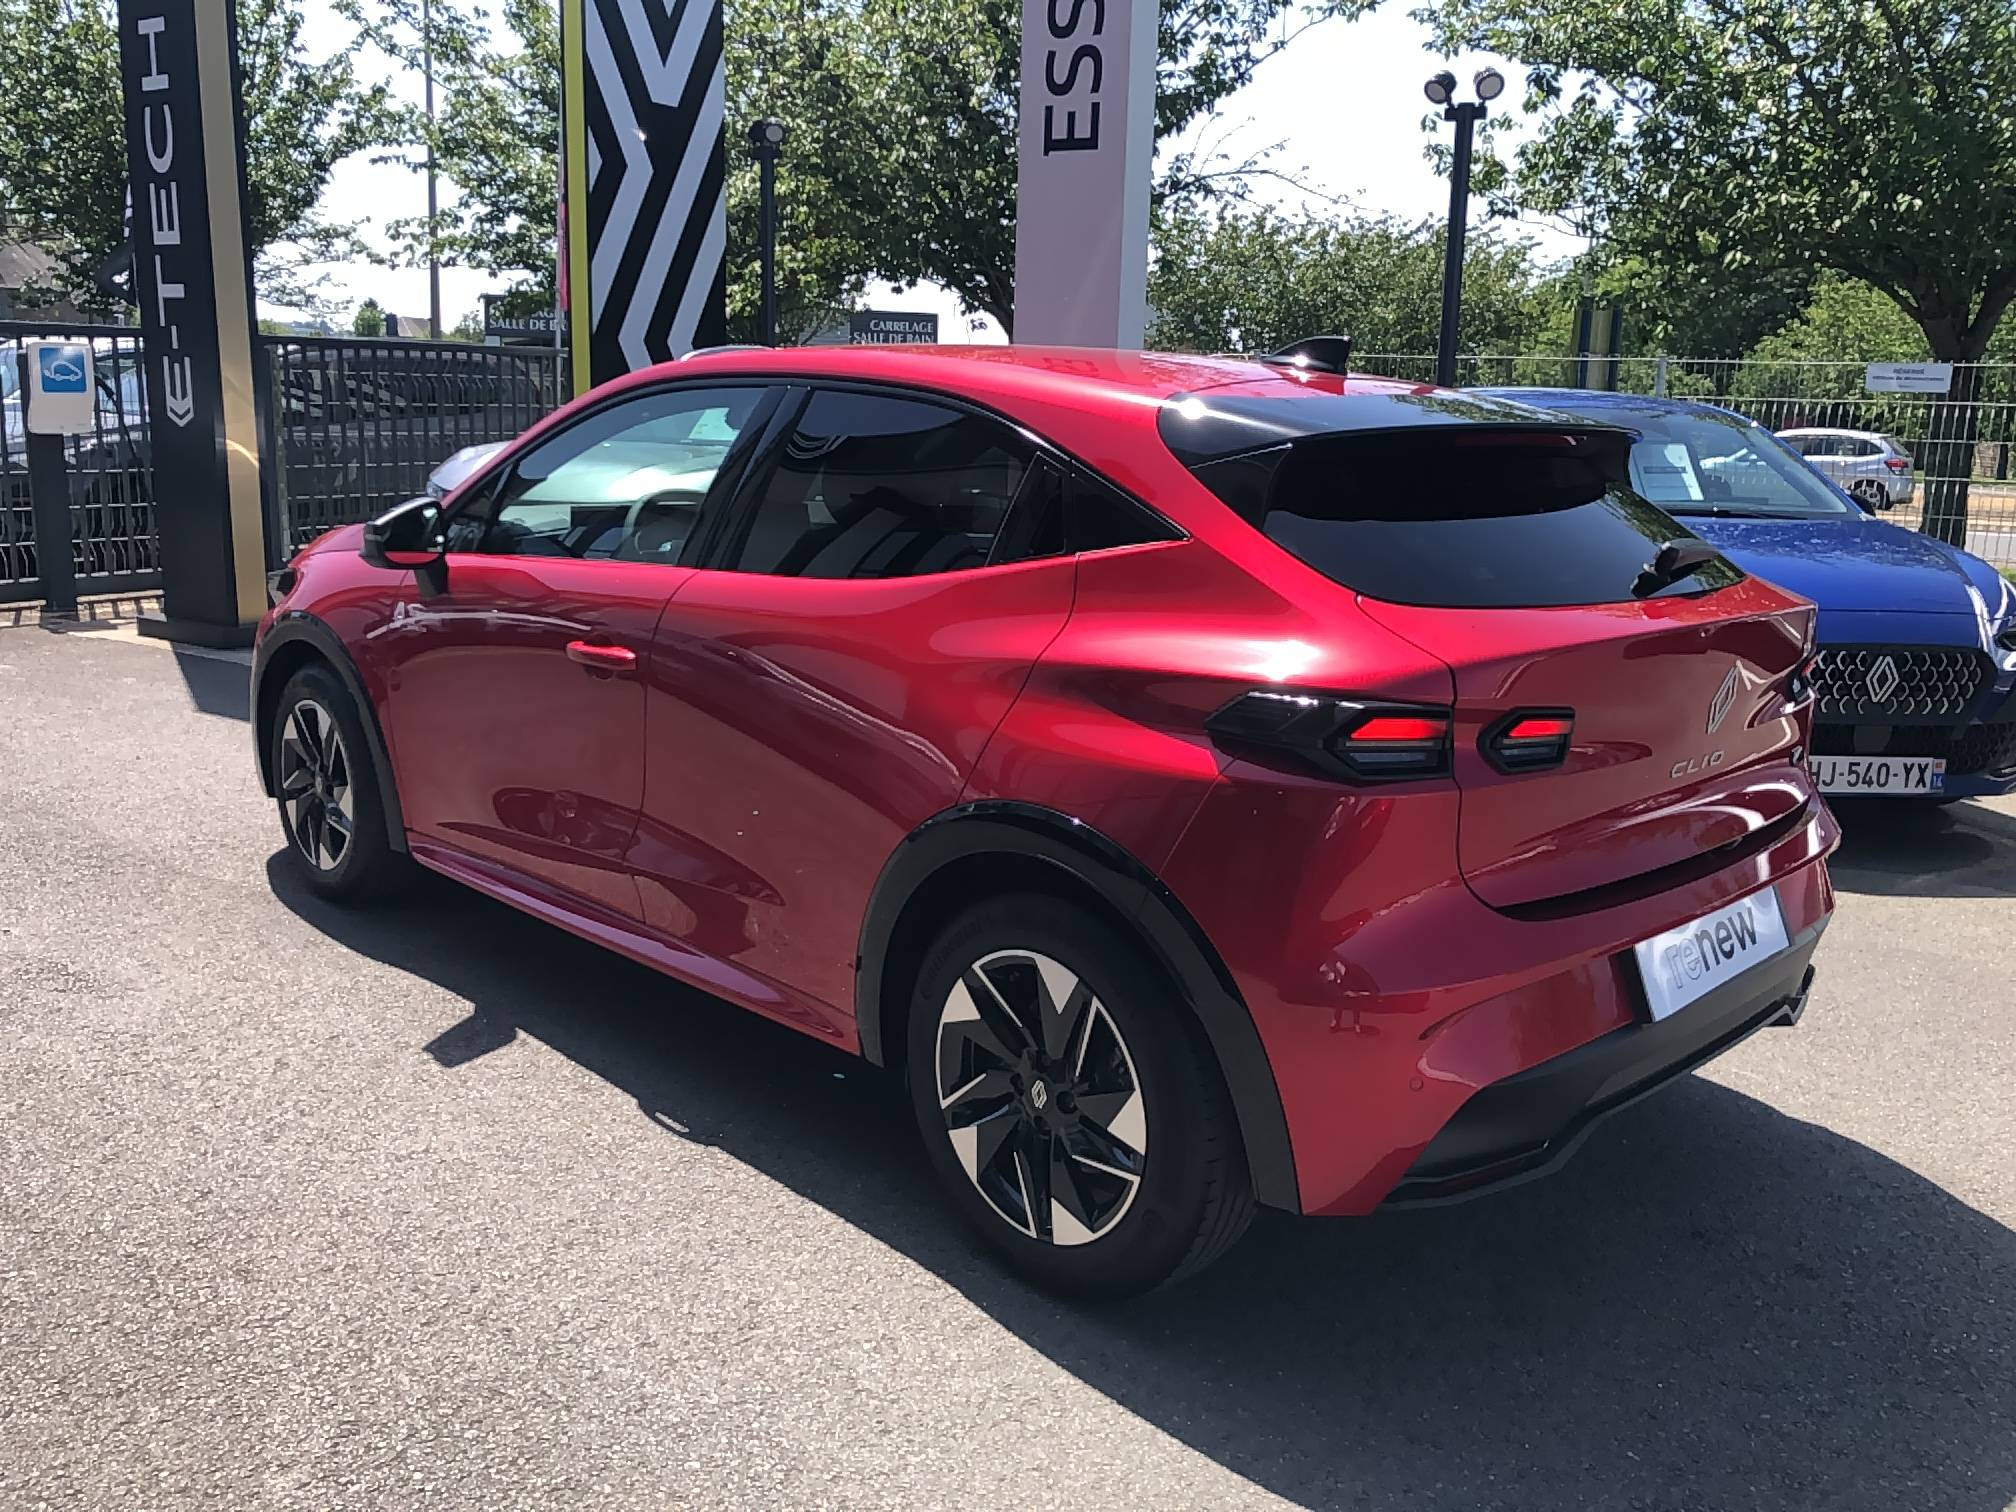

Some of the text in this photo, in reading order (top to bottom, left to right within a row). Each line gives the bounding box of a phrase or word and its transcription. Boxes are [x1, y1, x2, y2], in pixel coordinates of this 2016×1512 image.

[137, 15, 195, 428] E-TECH
[529, 319, 547, 331] DE
[853, 331, 885, 344] SALLE
[889, 333, 904, 344] DE
[869, 320, 934, 332] CARRELAGE
[1670, 750, 1725, 779] CLIO
[1808, 760, 1930, 788] HJ-540-YX
[1664, 906, 1758, 989] renew
